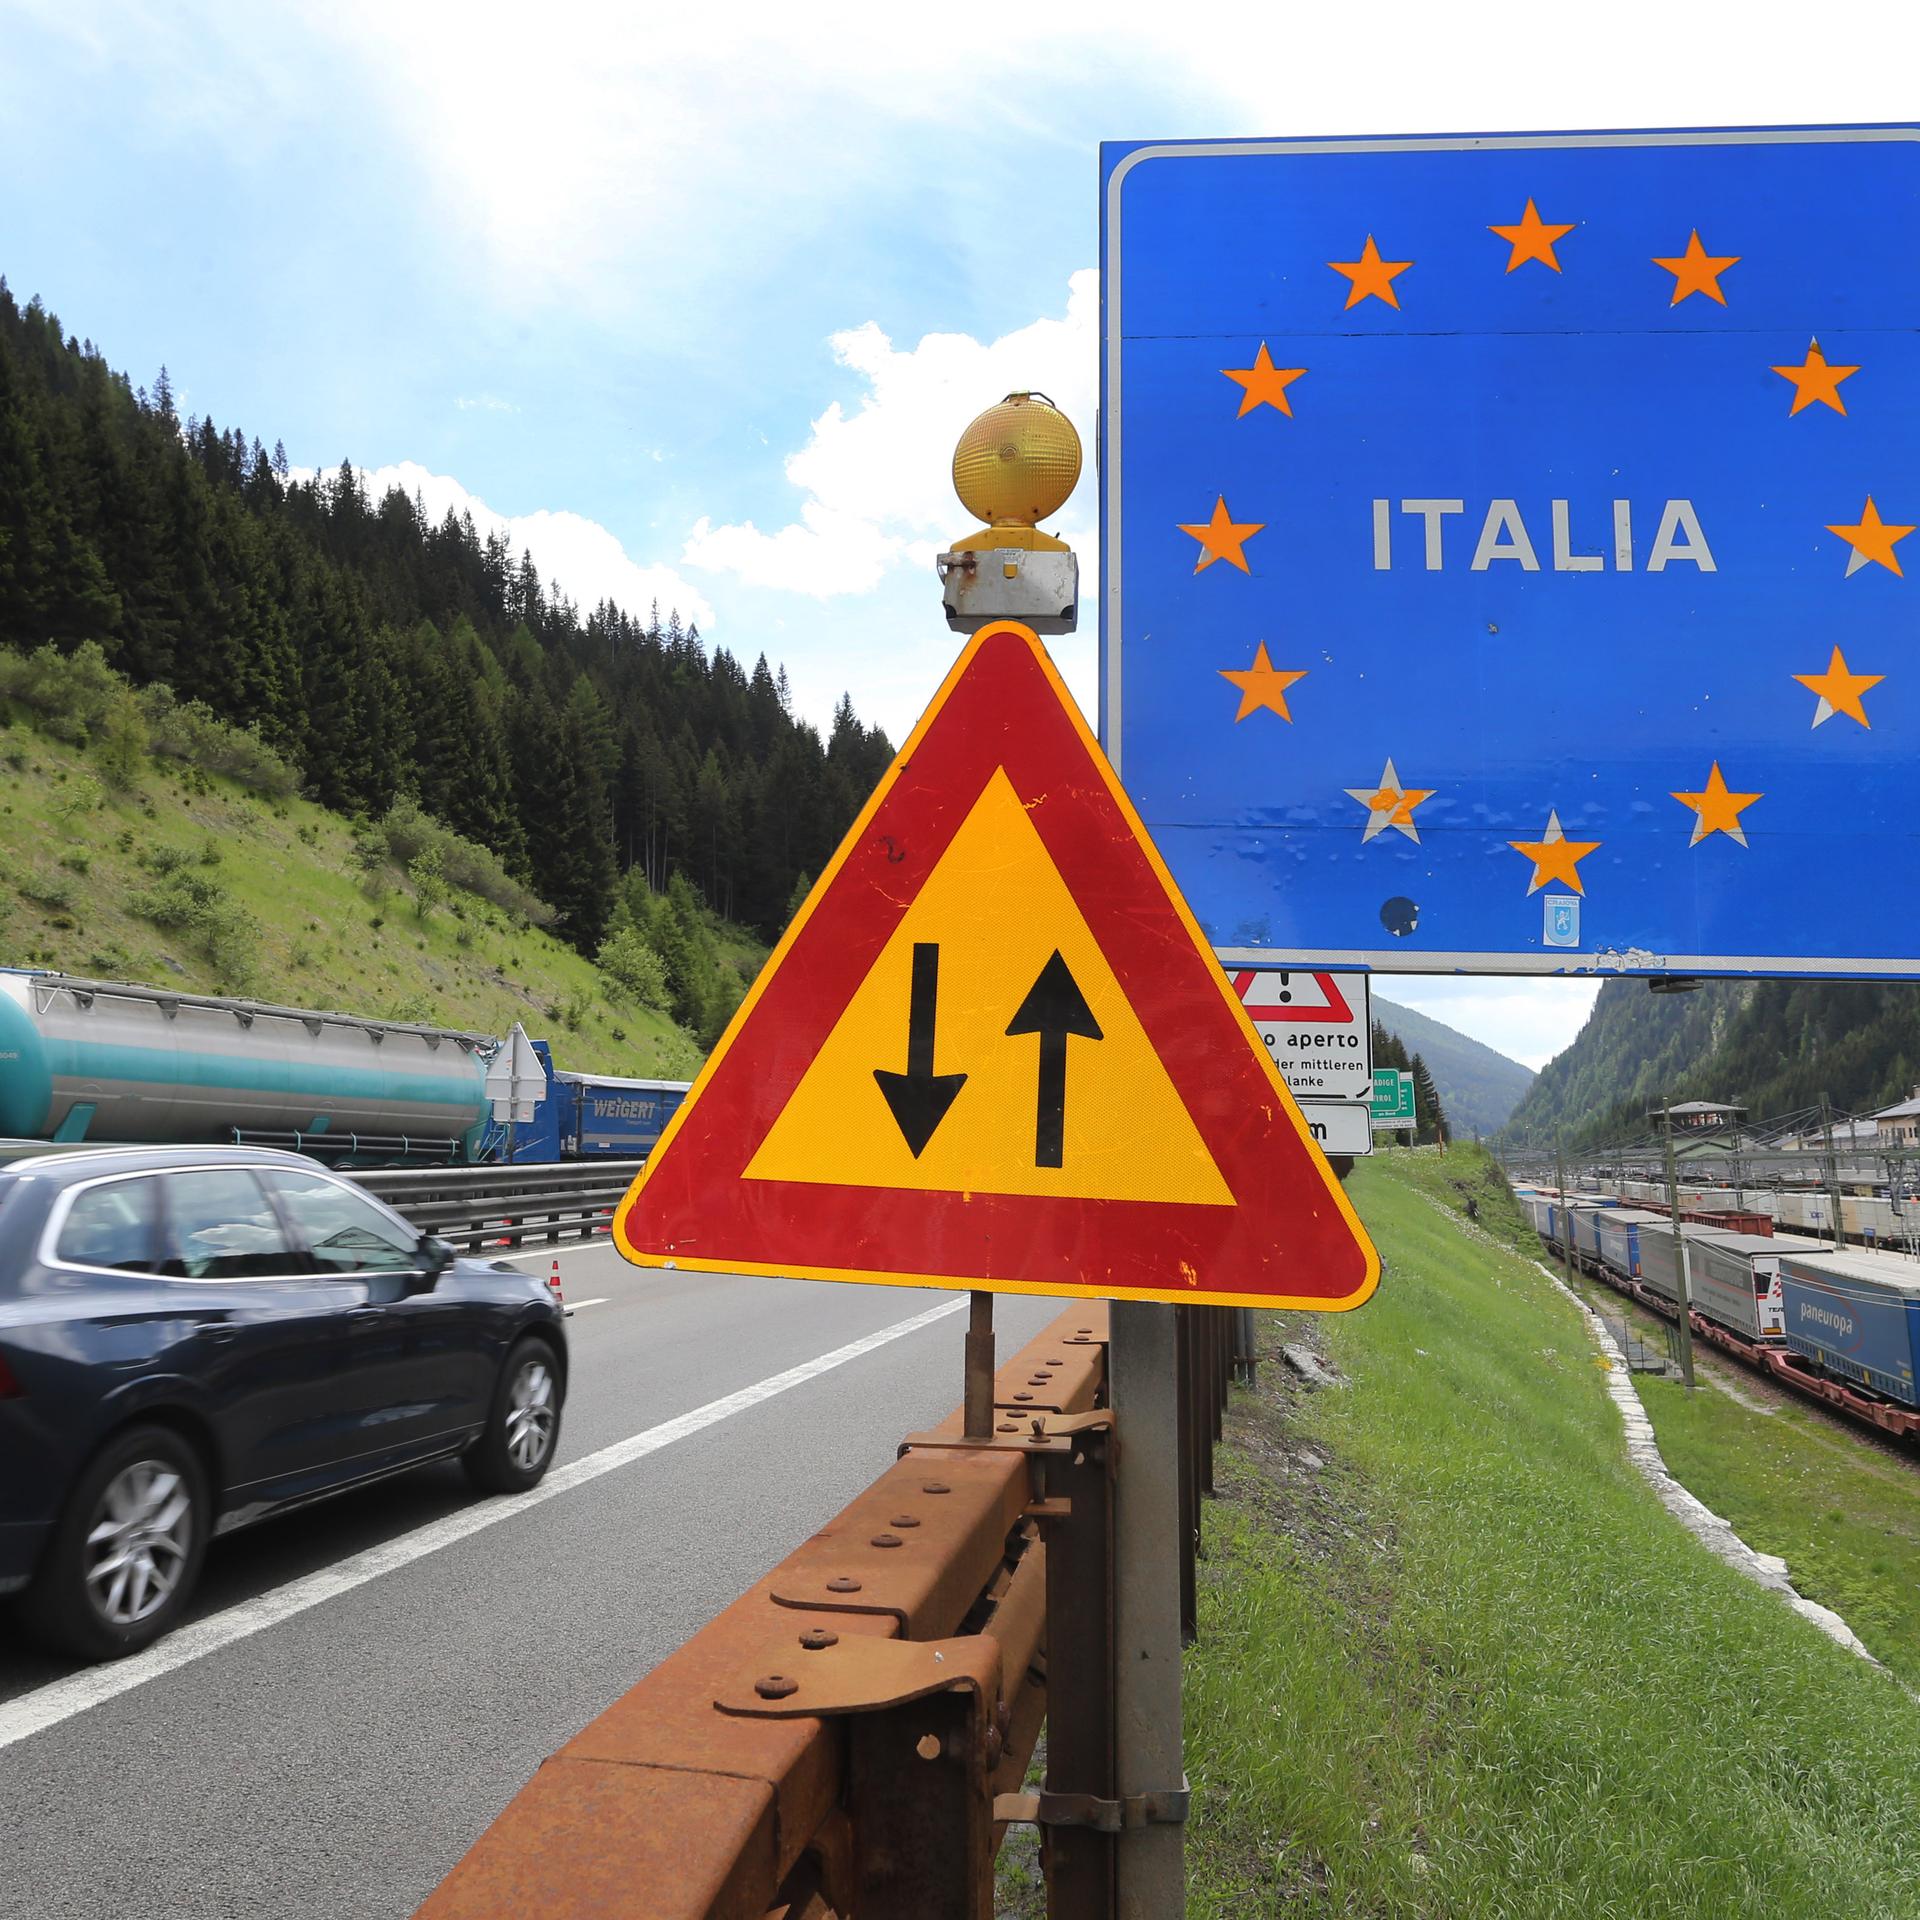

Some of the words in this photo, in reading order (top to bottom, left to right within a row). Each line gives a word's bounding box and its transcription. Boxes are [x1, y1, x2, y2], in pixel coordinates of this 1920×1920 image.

[1373, 498, 1718, 573] ITALIA
[1264, 1034, 1276, 1046] o
[1287, 1033, 1358, 1050] aperto
[1301, 1059, 1363, 1070] mittleren
[1287, 1075, 1324, 1087] lanke
[1800, 1302, 1853, 1337] paneuropa
